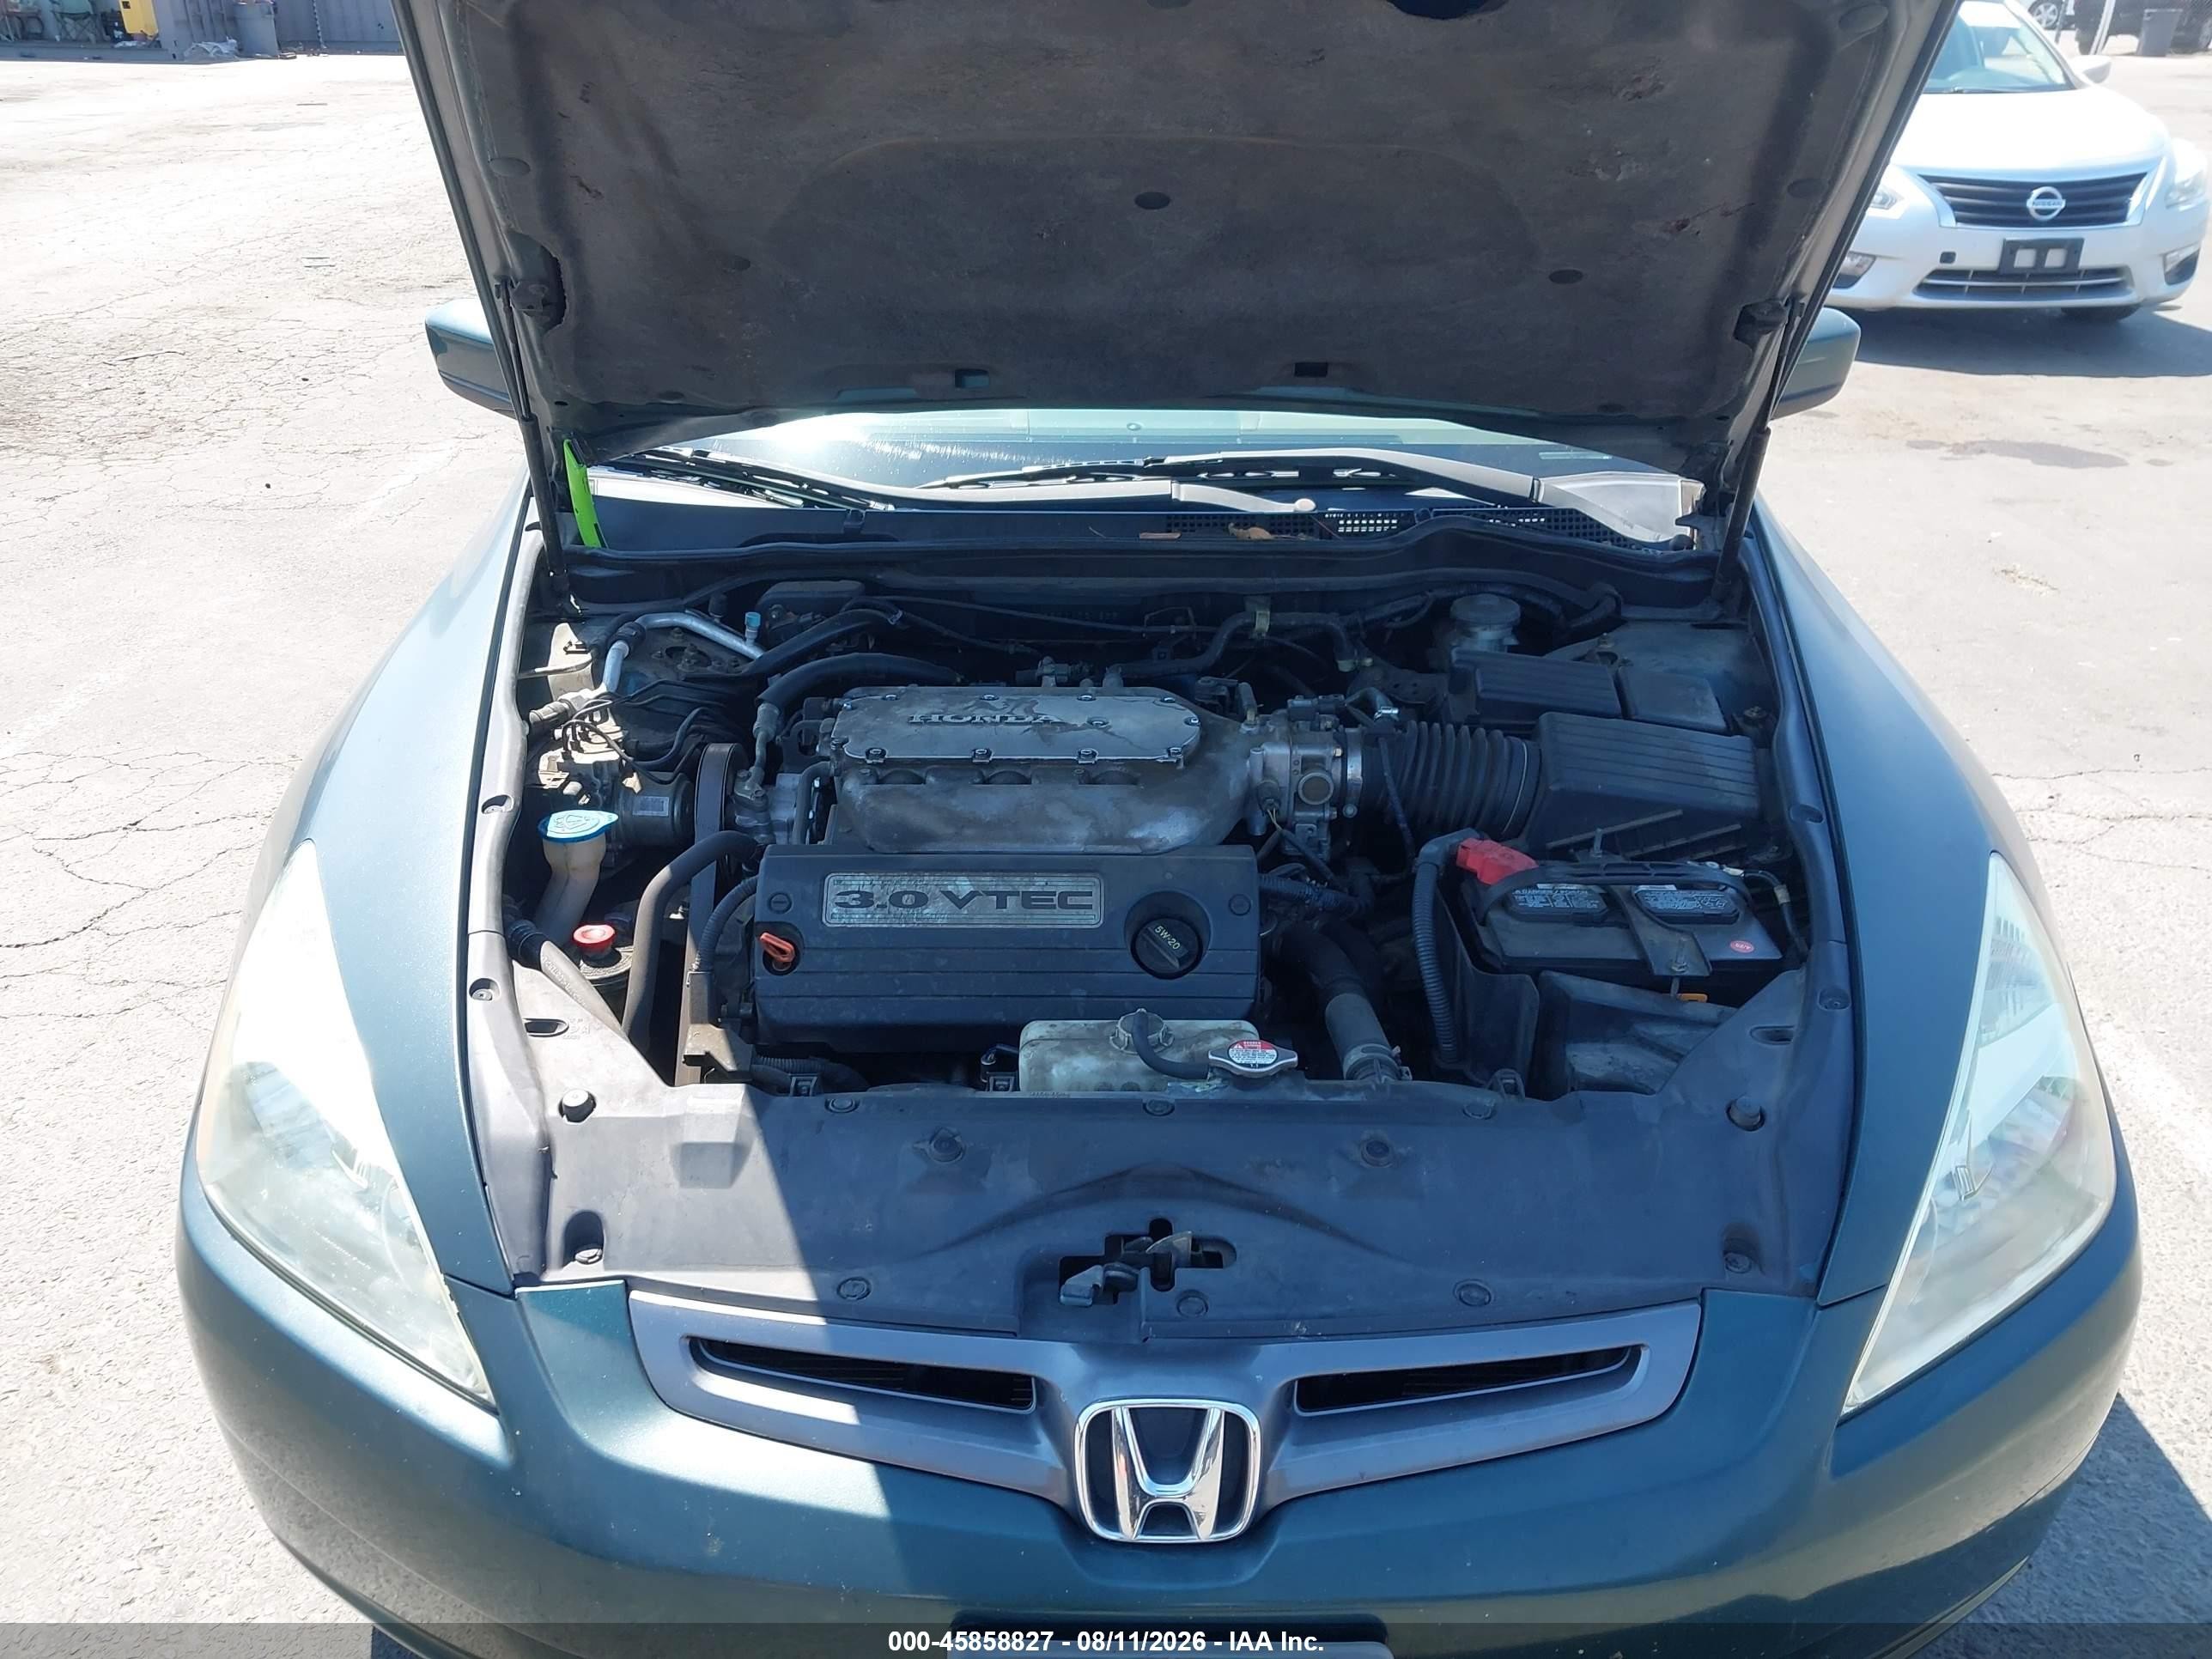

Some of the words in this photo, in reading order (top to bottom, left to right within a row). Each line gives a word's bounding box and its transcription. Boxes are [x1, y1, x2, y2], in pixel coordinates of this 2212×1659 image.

[908, 714, 1063, 725] HONDA
[834, 890, 929, 909] 3.0
[940, 890, 1093, 910] VTEC
[1154, 926, 1181, 950] 5W-20
